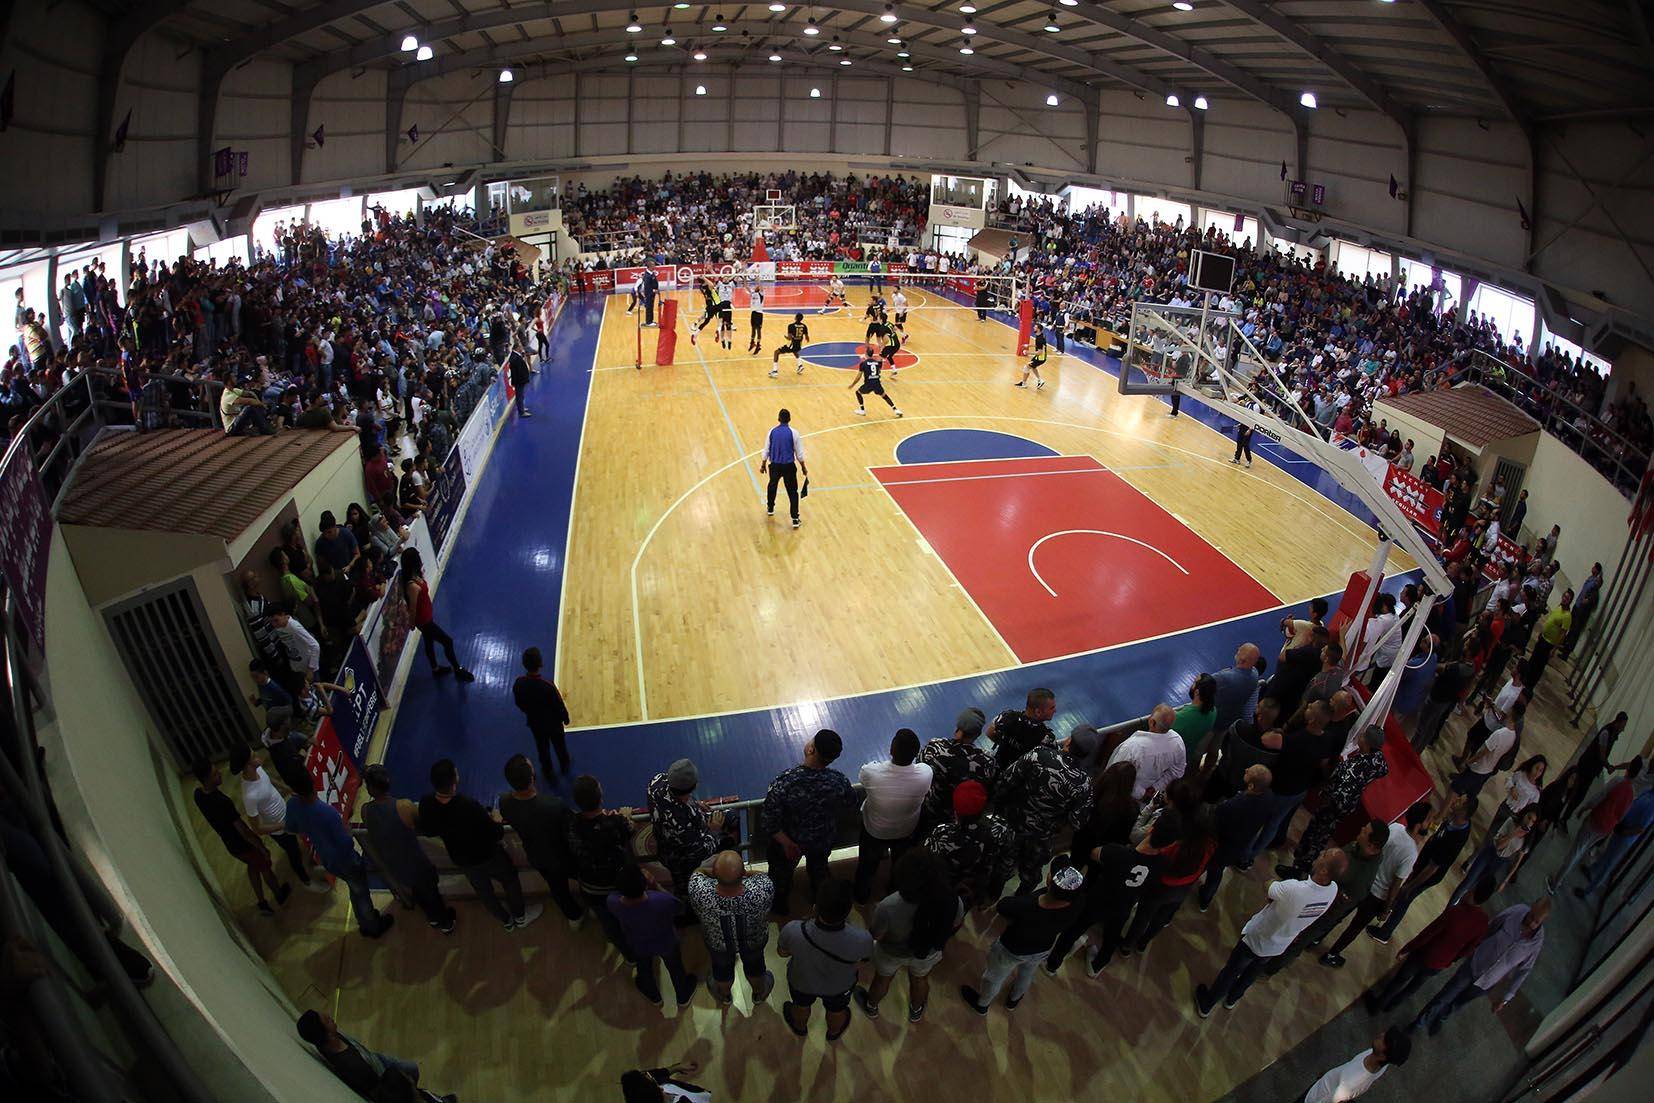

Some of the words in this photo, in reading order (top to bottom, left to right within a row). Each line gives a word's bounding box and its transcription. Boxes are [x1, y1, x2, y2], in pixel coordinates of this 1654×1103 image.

[870, 364, 877, 376] 9
[1389, 476, 1426, 515] XXL
[1124, 864, 1150, 887] 3
